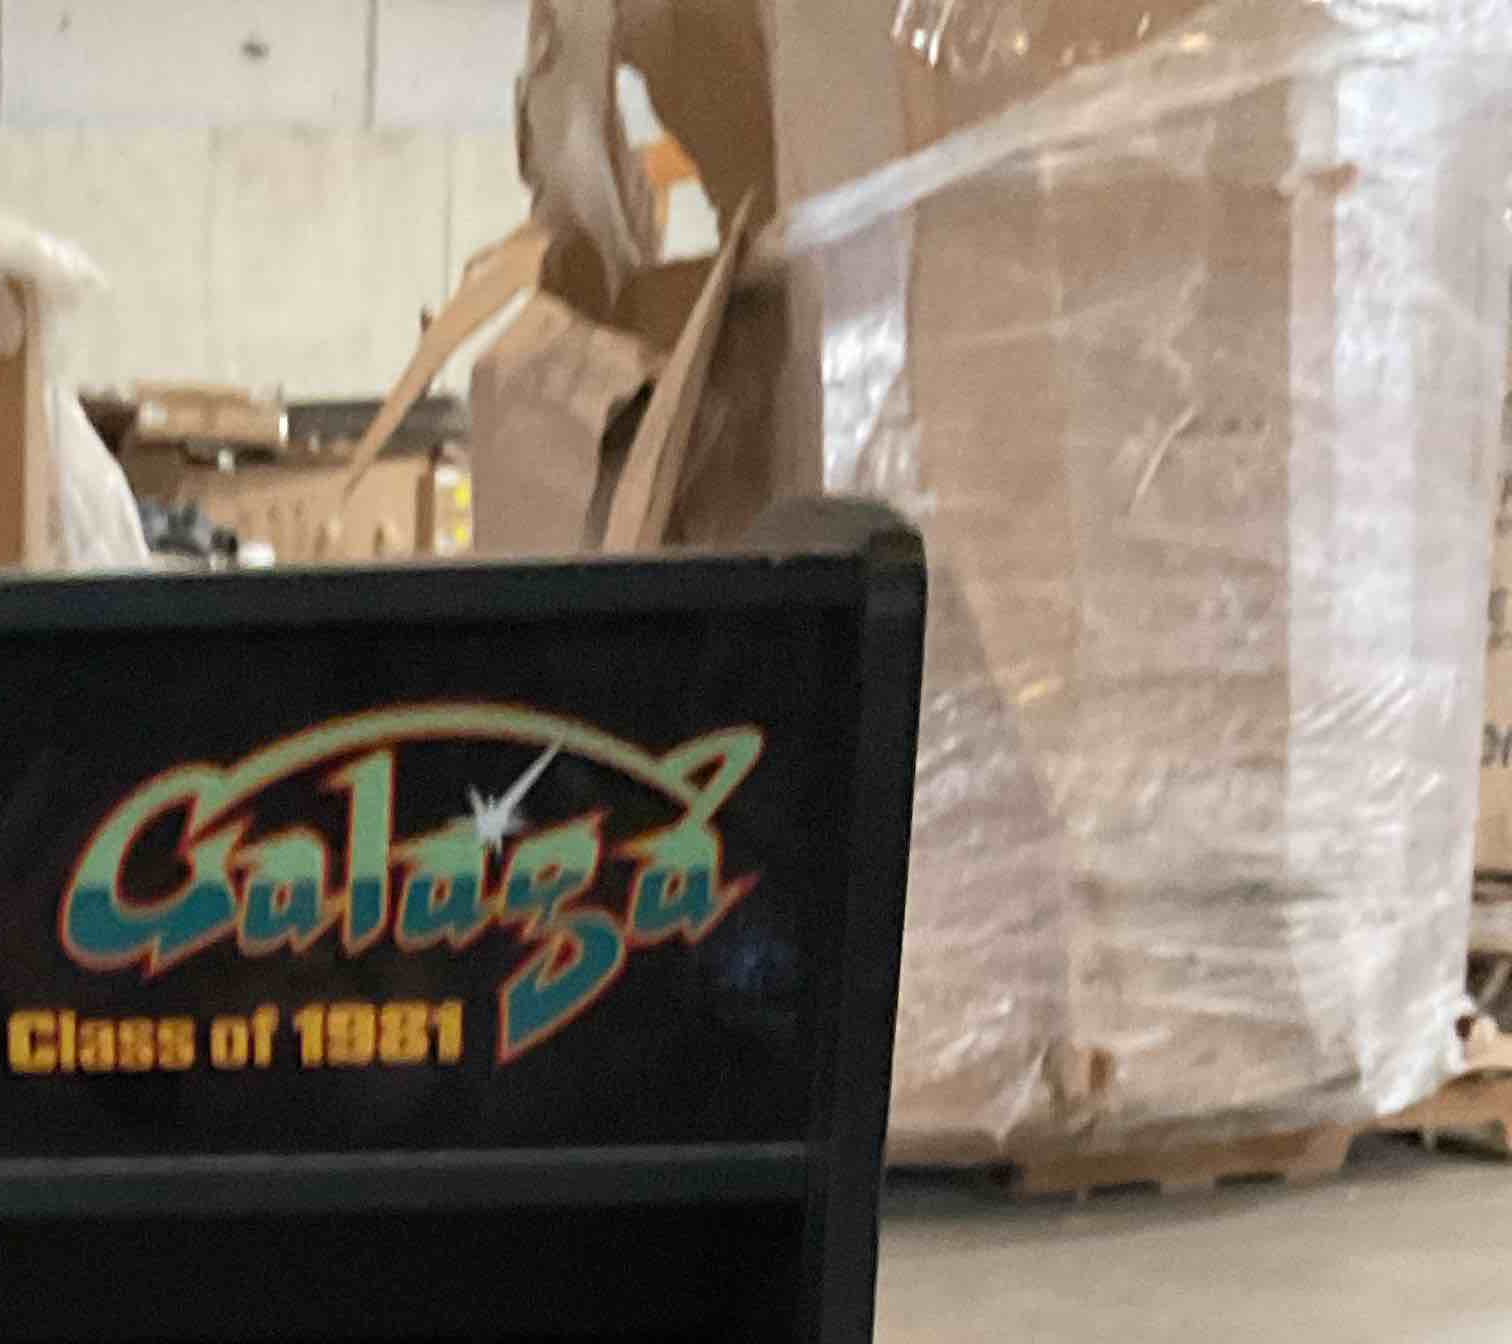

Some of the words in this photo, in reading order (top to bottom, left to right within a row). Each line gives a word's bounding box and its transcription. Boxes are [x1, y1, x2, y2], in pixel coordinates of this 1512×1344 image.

[60, 698, 765, 1066] Galaga
[7, 1008, 196, 1073] Class
[210, 1001, 280, 1070] of
[294, 999, 465, 1069] 1981
